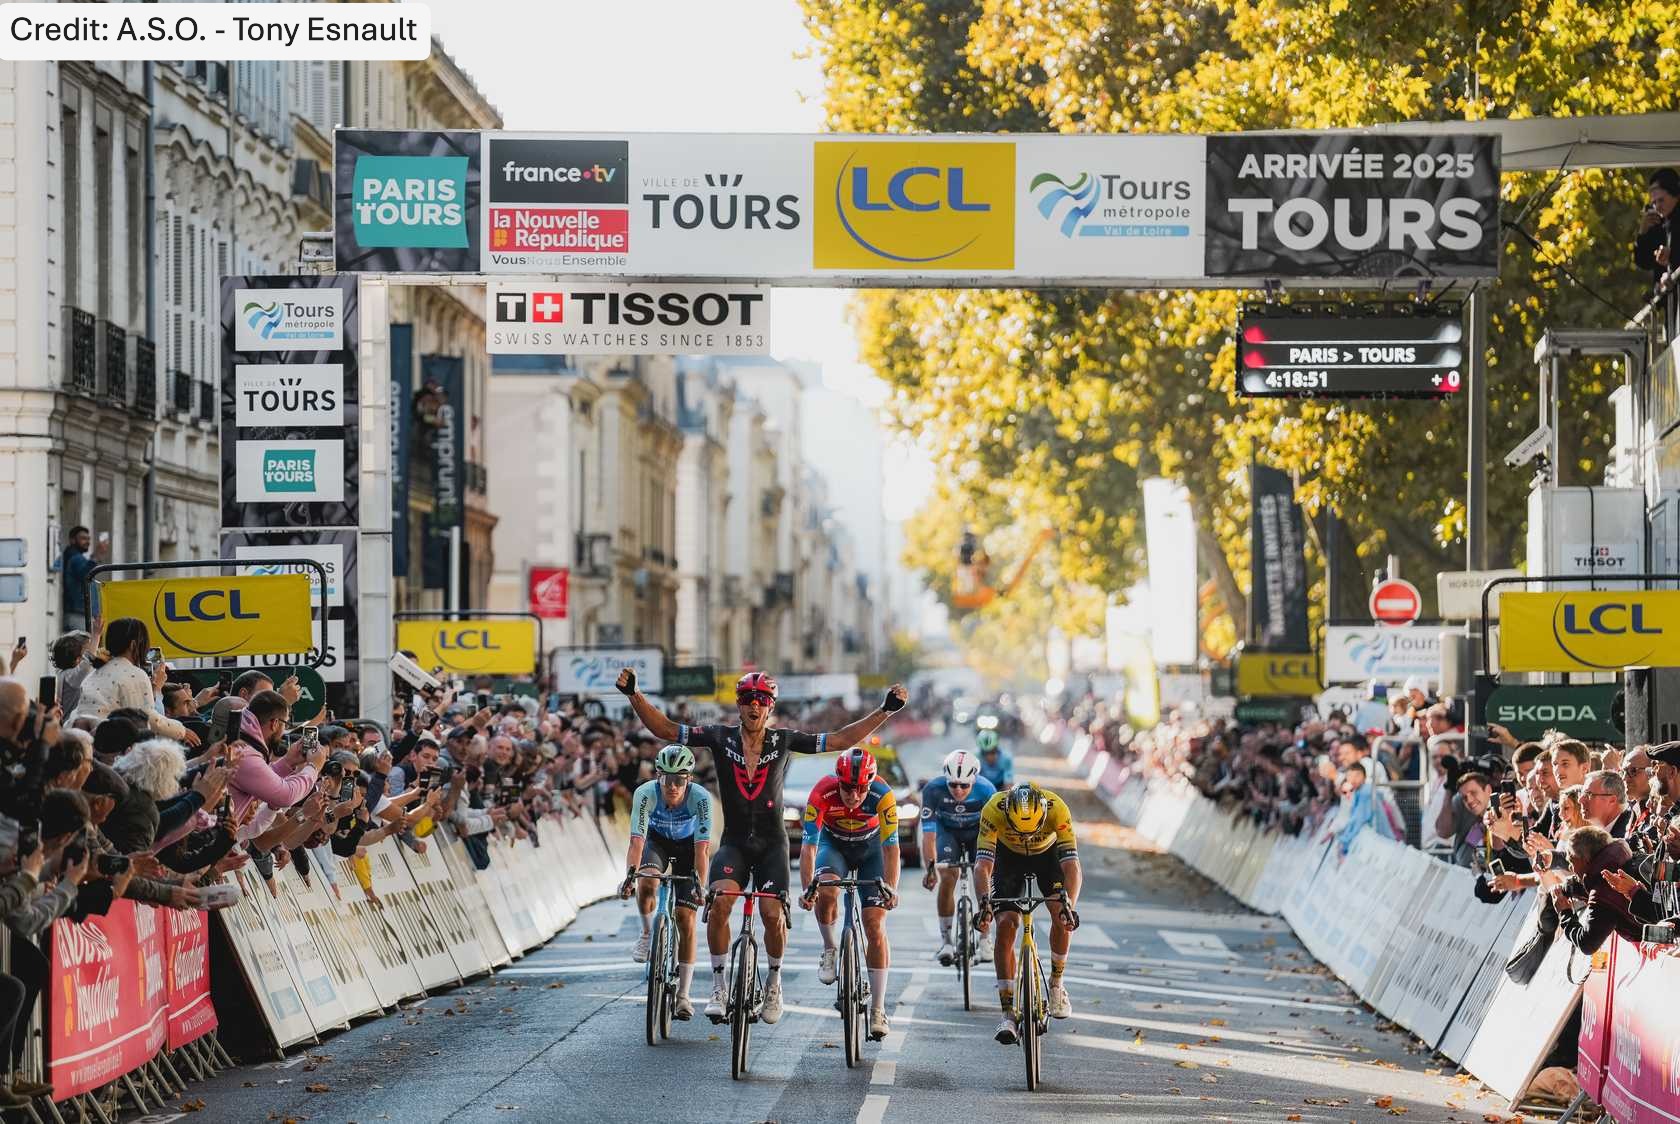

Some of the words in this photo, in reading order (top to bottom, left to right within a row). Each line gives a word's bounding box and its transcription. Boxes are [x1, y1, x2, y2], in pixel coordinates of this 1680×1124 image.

[1238, 147, 1384, 180] ARRIVÉE
[1393, 154, 1474, 180] 2025
[363, 178, 456, 201] PARIS
[642, 177, 678, 188] VILLE
[683, 177, 700, 188] DE
[852, 166, 990, 212] LCL
[1101, 174, 1191, 200] Tours
[356, 202, 462, 227] TOURS
[494, 210, 511, 229] la
[515, 210, 600, 229] Nouvelle
[643, 194, 800, 231] TOURS
[1103, 205, 1191, 221] métropole
[1104, 226, 1122, 236] Val
[1126, 226, 1140, 236] de
[1143, 226, 1172, 236] Loire
[1228, 198, 1484, 250] TOURS
[515, 229, 624, 251] République
[284, 302, 335, 318] Tours
[570, 293, 763, 326] TISSOT
[285, 320, 335, 330] métropole
[494, 333, 553, 346] SWISS
[564, 333, 649, 347] WATCHES
[660, 333, 714, 347] SINCE
[726, 334, 764, 348] 1853
[1290, 348, 1338, 363] PARIS
[1358, 347, 1416, 363] TOURS
[1265, 371, 1328, 388] 4:18:51
[1447, 371, 1460, 387] 0
[243, 390, 336, 412] TOURS
[267, 459, 311, 471] PARIS
[265, 471, 313, 483] TOURS
[1574, 557, 1625, 567] TISSOT
[164, 589, 260, 622] LCL
[1564, 603, 1662, 634] LCL
[439, 629, 500, 650] LCL
[606, 657, 646, 669] Tours
[1270, 661, 1316, 676] LCL
[1499, 705, 1597, 721] SKODA
